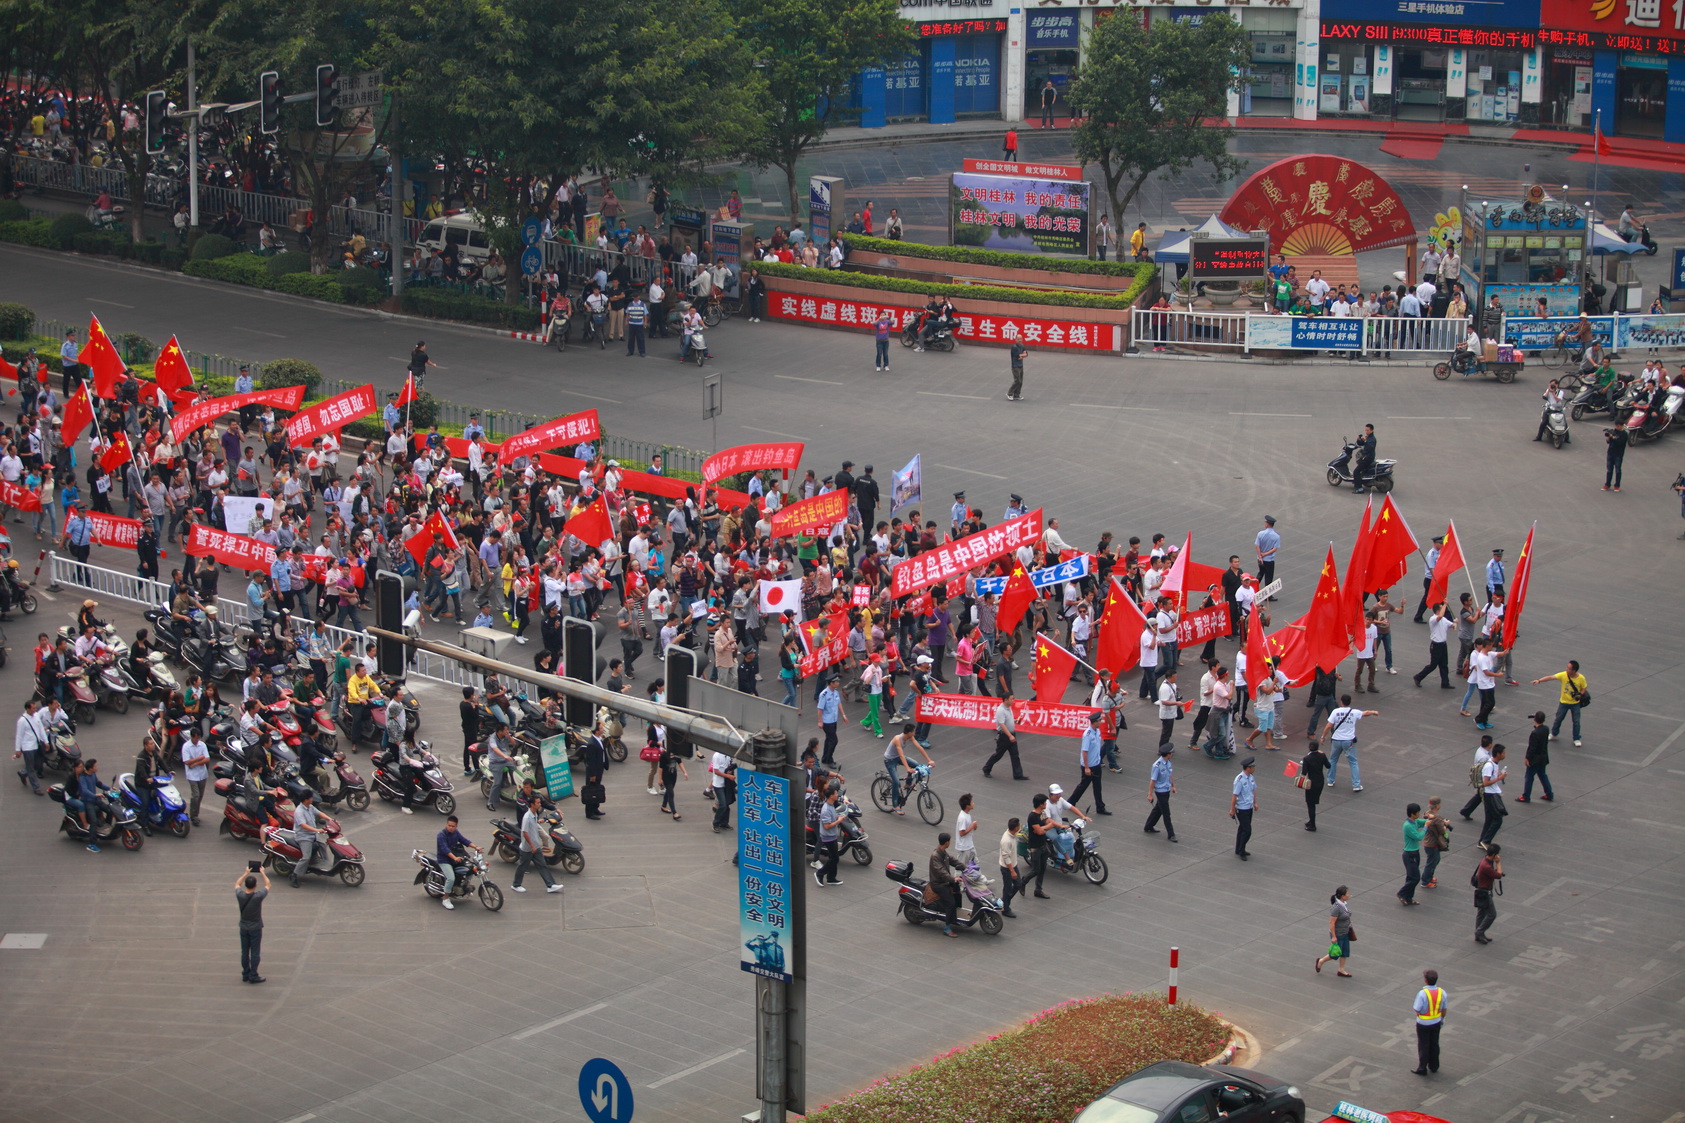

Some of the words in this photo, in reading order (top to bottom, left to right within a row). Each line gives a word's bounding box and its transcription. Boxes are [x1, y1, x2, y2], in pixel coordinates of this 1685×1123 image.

[1398, 2, 1464, 15] 三星手机体验店
[1030, 17, 1072, 28] 步步高
[1036, 28, 1069, 38] 音乐手机
[1320, 24, 1361, 38] LAXY
[976, 162, 1018, 173] 创全国文明城
[1025, 165, 1068, 177] 做文明桂林人
[961, 187, 1016, 204] 文明桂林
[1024, 192, 1081, 209] 我的责任
[960, 209, 1016, 227] 桂林文明
[1024, 214, 1081, 233] 我的光荣
[1295, 331, 1357, 341] 心情时时舒畅
[1298, 321, 1358, 331] 驾车相互礼让
[741, 448, 795, 467] 滚出钓鱼岛
[897, 517, 1038, 592] 钓鱼岛是中国的领土
[1193, 610, 1227, 638] 振兴中华
[1020, 706, 1105, 731] 大力支持国
[743, 775, 761, 821] 人让车
[765, 779, 783, 829] 车让人
[743, 828, 763, 923] 让出一份安全
[765, 834, 785, 929] 让出一份文明
